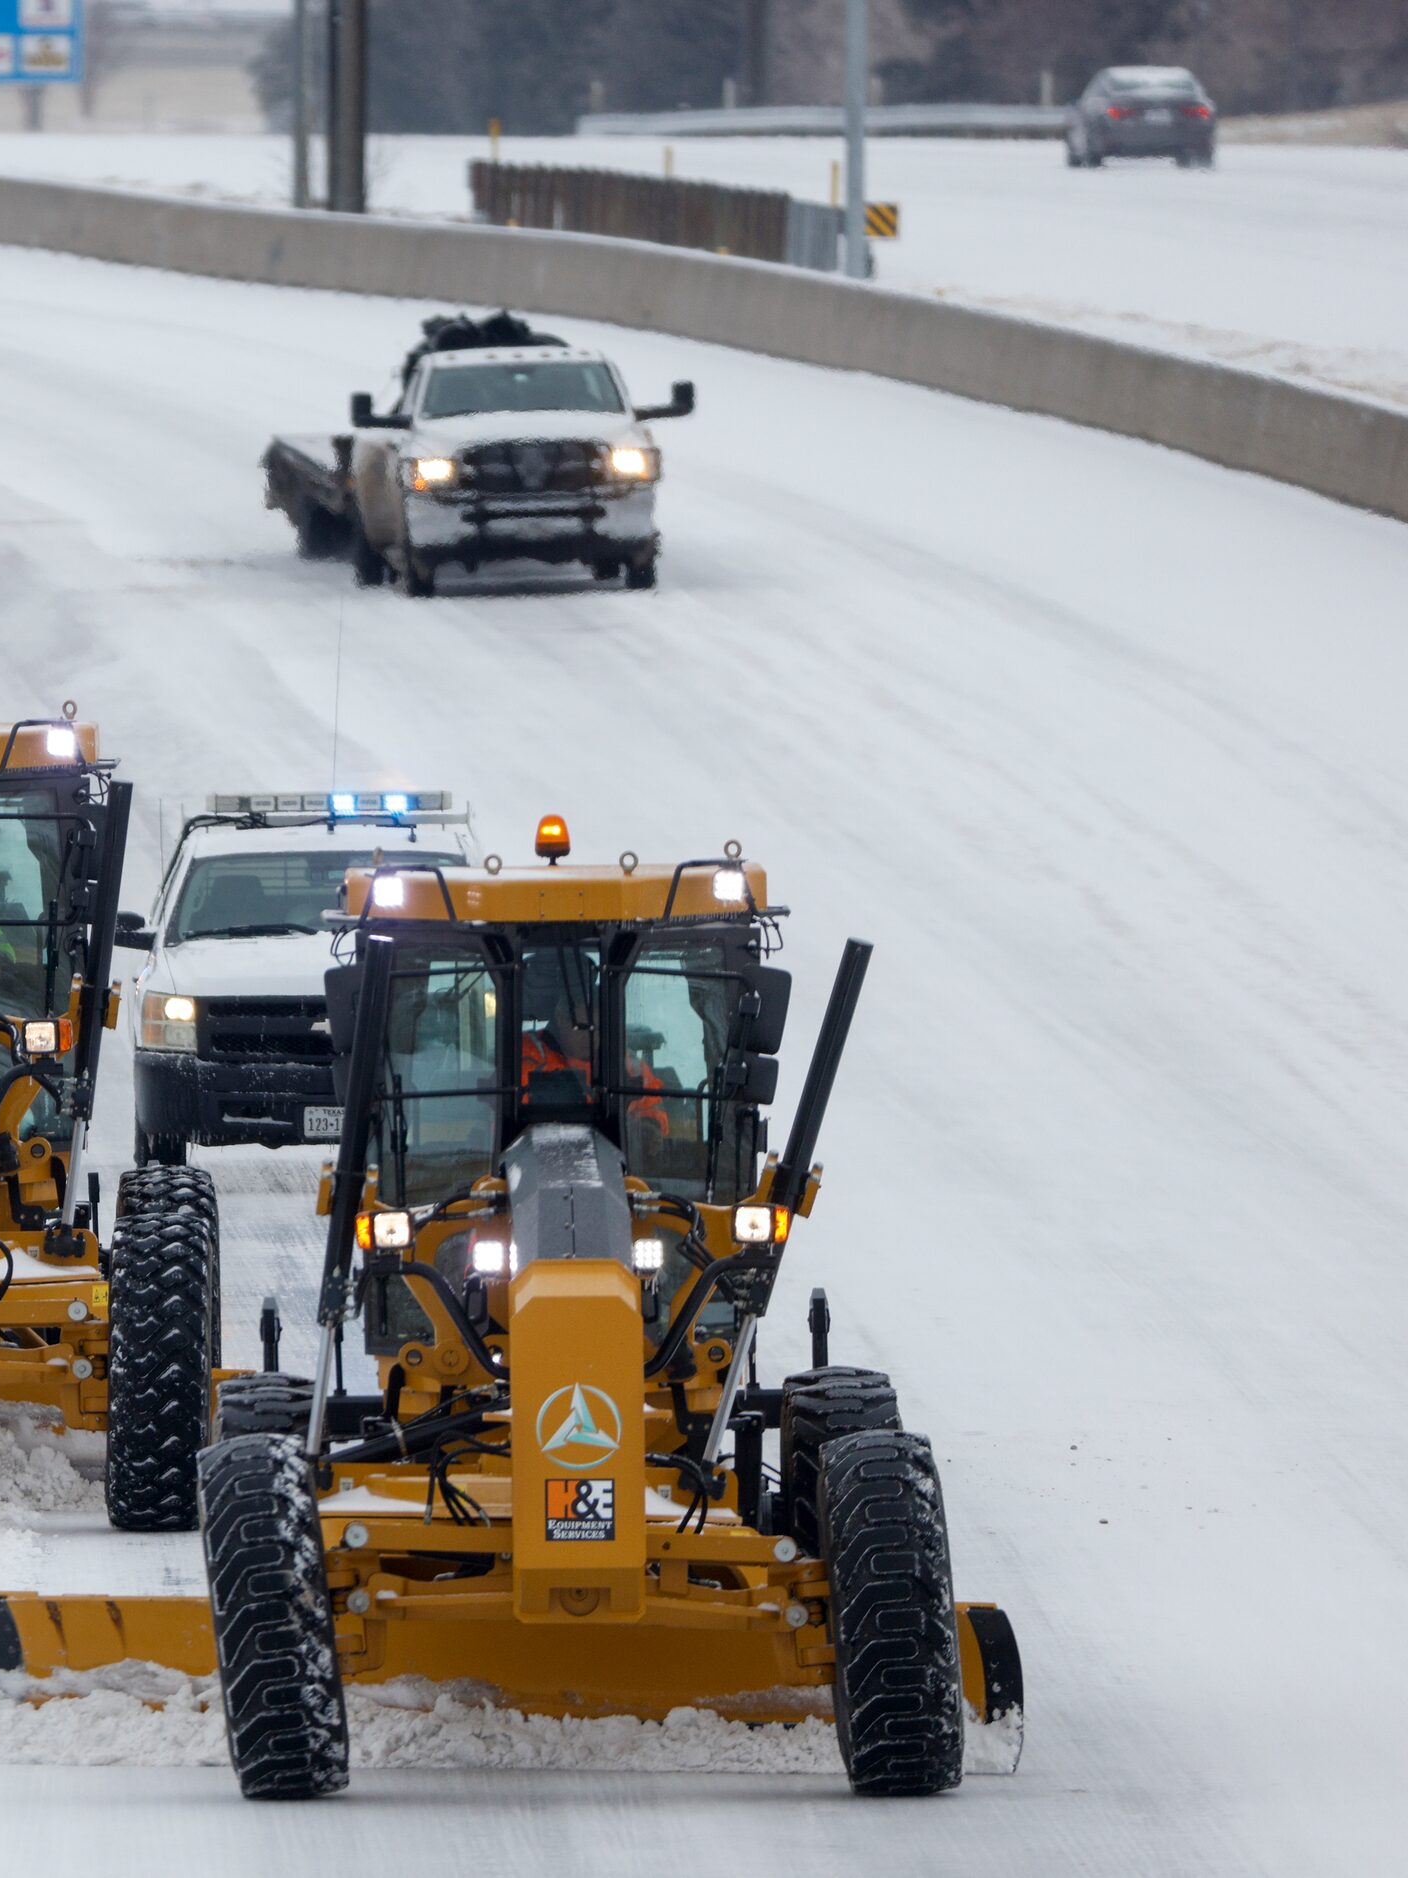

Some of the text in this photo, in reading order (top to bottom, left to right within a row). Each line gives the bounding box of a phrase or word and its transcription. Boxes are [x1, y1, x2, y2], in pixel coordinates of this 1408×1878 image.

[308, 1117, 342, 1131] 123-1
[547, 1480, 612, 1518] H&E
[548, 1520, 613, 1530] EQUIPMENT
[553, 1529, 605, 1539] SERVICES
